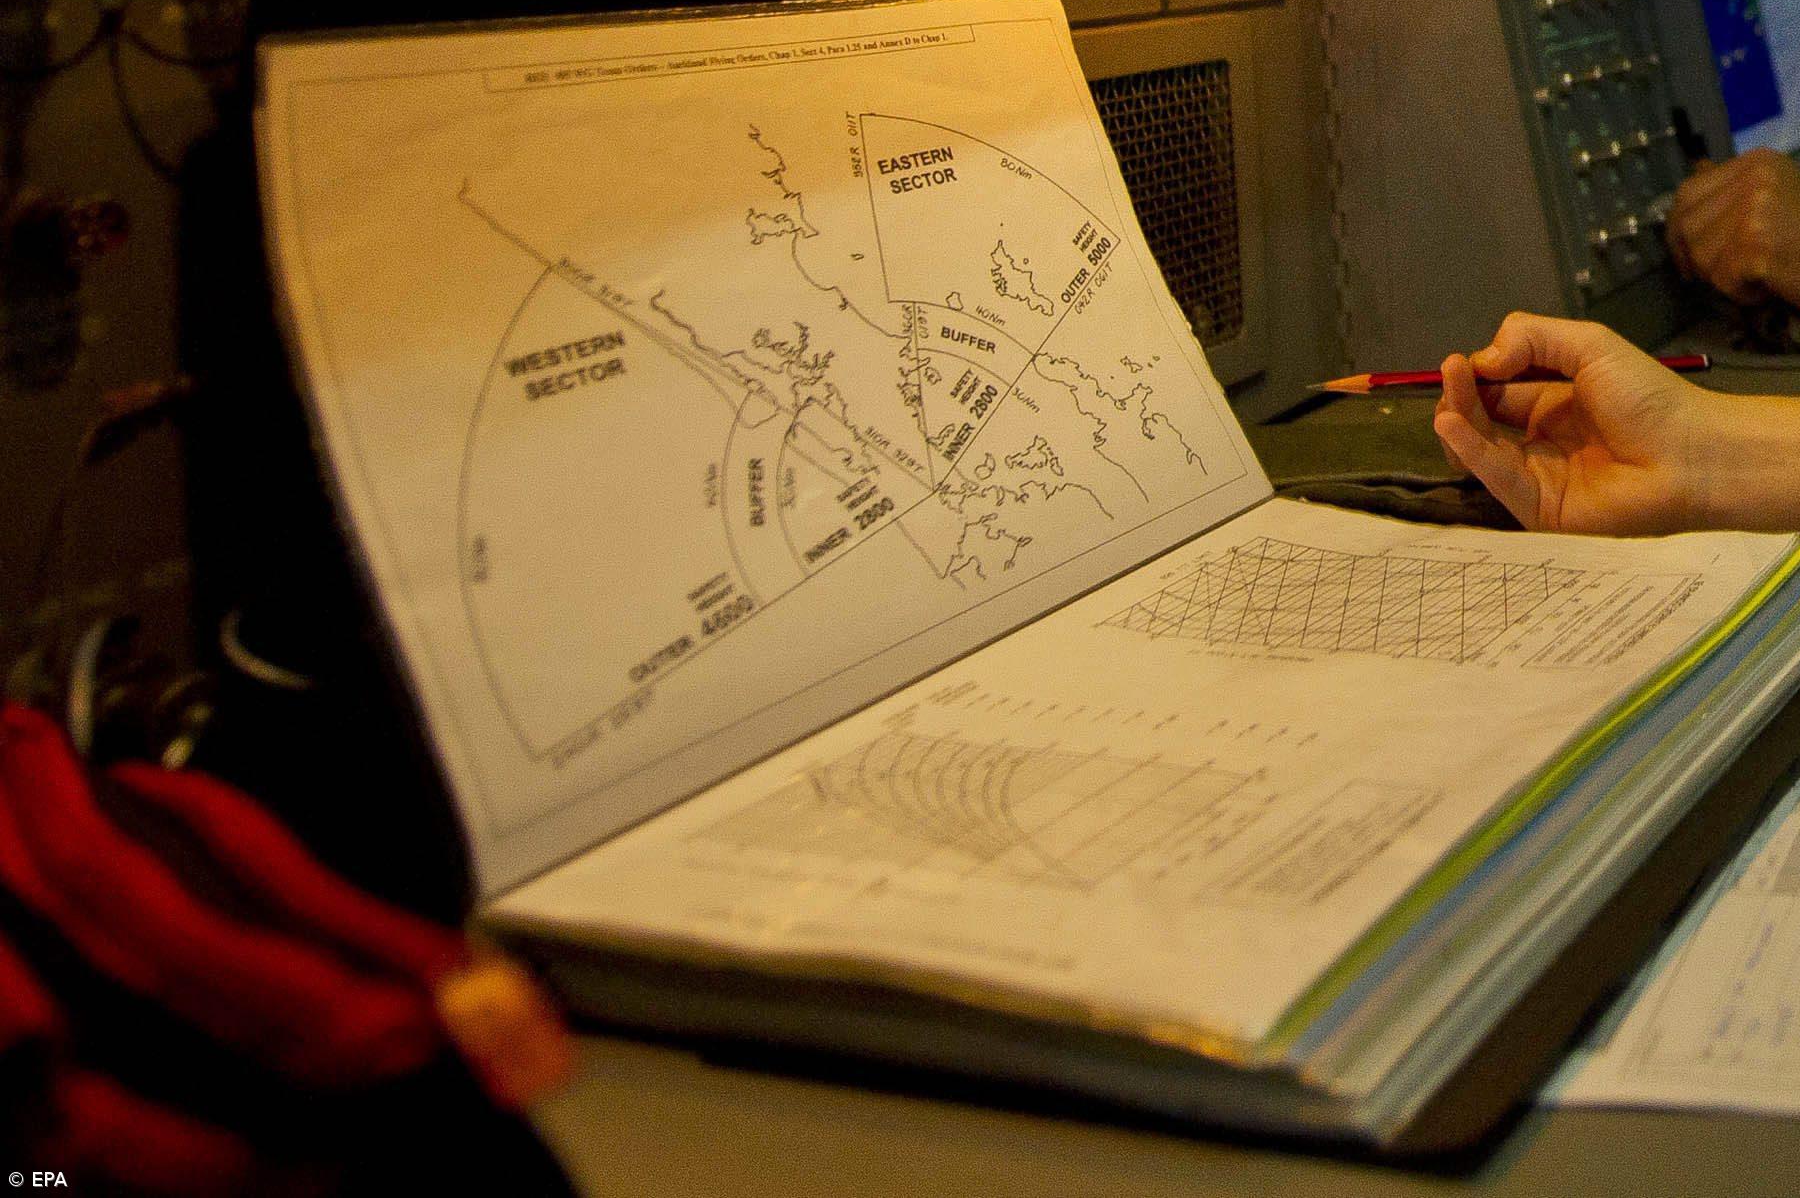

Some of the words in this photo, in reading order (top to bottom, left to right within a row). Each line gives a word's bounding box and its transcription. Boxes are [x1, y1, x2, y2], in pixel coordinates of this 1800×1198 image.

[880, 38, 903, 49] Annex
[921, 34, 939, 44] Chap
[877, 146, 954, 175] EASTERN
[999, 157, 1033, 181] 80Nm
[890, 167, 957, 194] SECTOR
[1072, 220, 1092, 245] SAFETY
[1079, 228, 1098, 253] HEIGHT
[1061, 267, 1091, 303] OUTER
[1087, 237, 1112, 266] 5000
[504, 330, 626, 377] WESTERN
[940, 326, 996, 354] BUFFER
[525, 357, 626, 402] SECTOR
[942, 422, 976, 461] INNER
[969, 384, 998, 420] 2800
[748, 457, 765, 527] BUFFER
[803, 527, 852, 563] INNER
